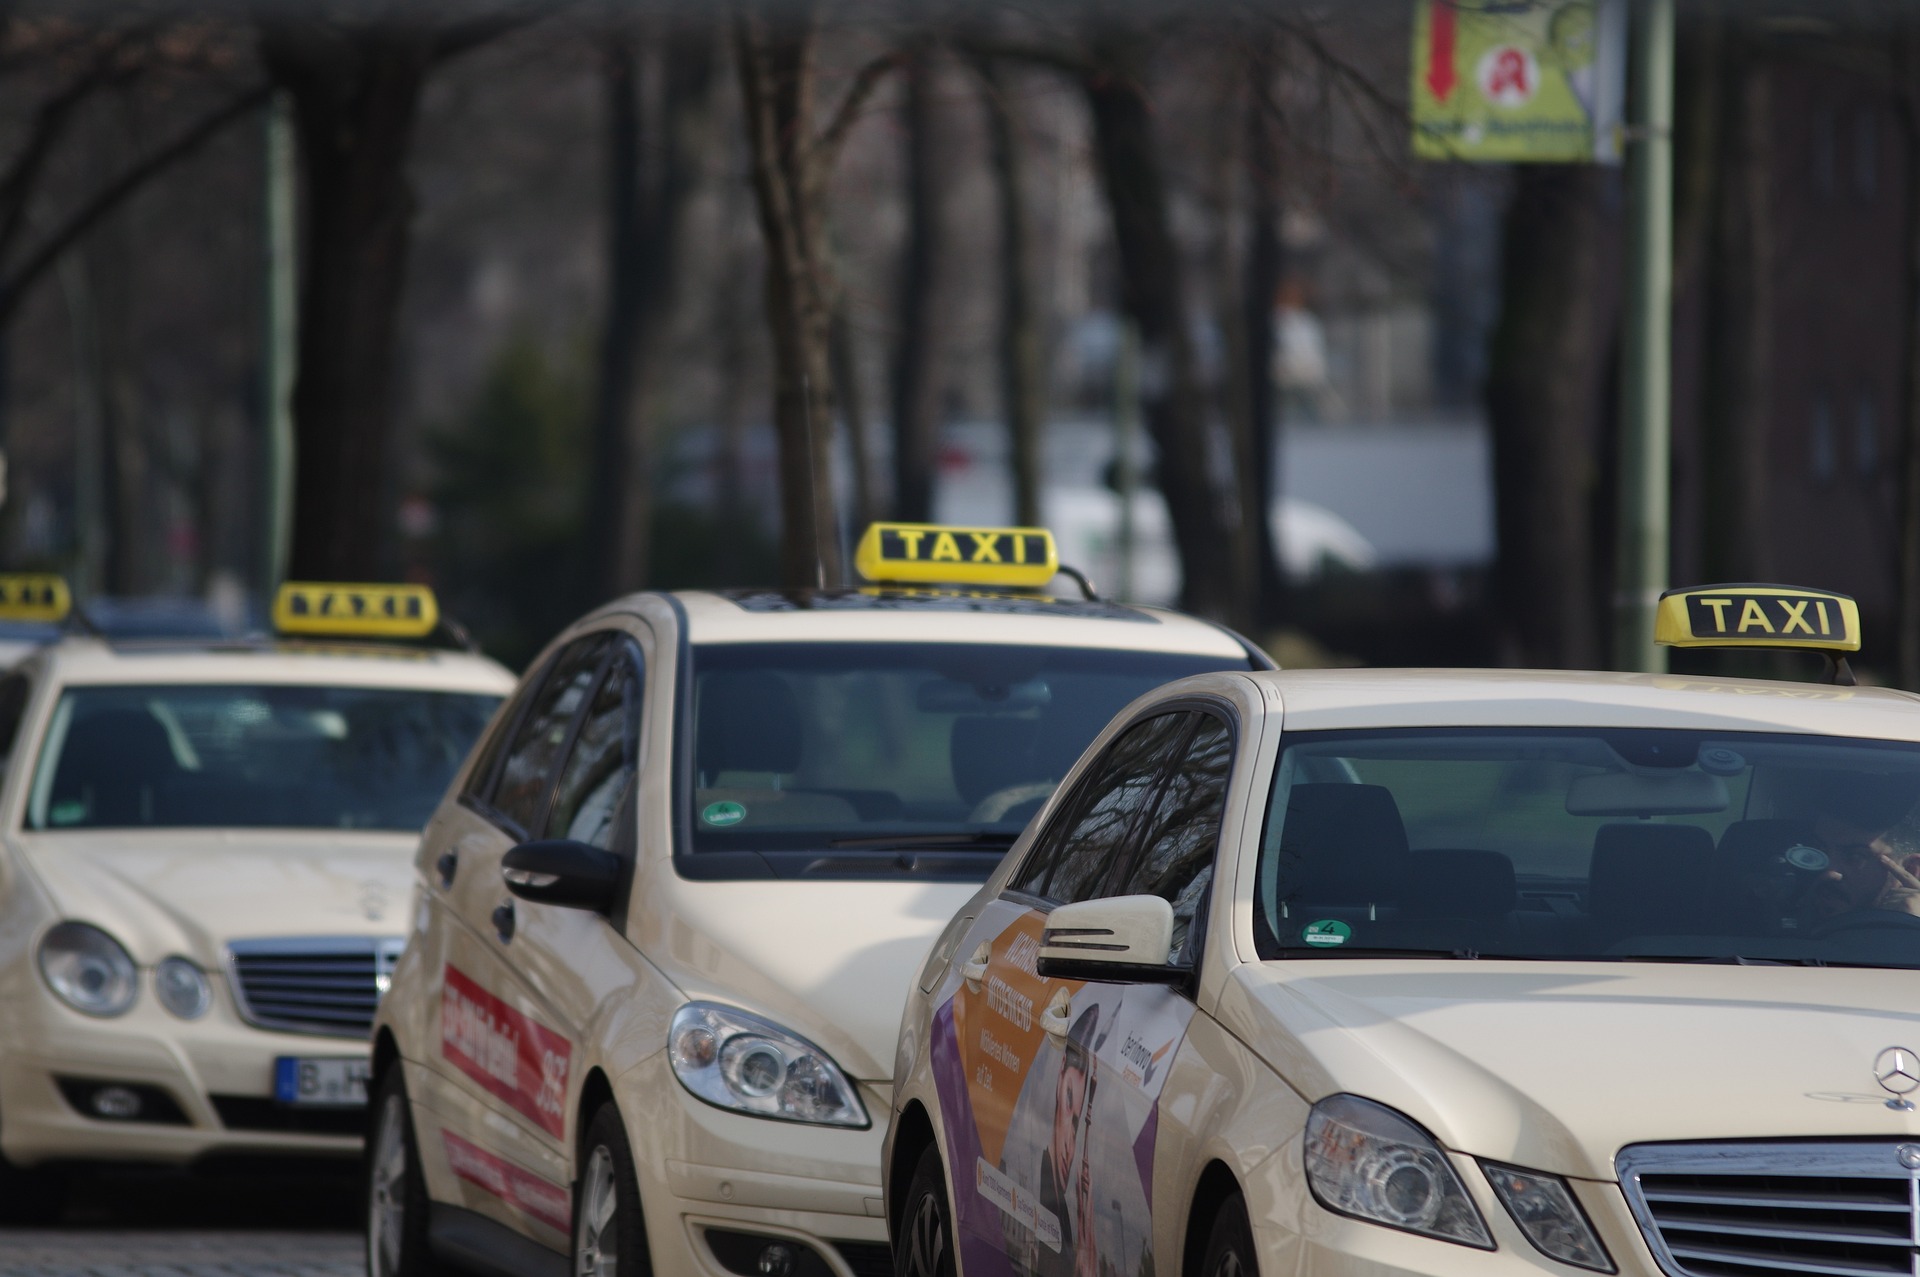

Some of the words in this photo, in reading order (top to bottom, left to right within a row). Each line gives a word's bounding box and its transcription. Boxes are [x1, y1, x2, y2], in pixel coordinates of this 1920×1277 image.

[897, 530, 1027, 564] TAXI
[1700, 598, 1831, 635] TAXI
[1321, 921, 1335, 934] 4
[987, 975, 1033, 1033] MITDENKEND
